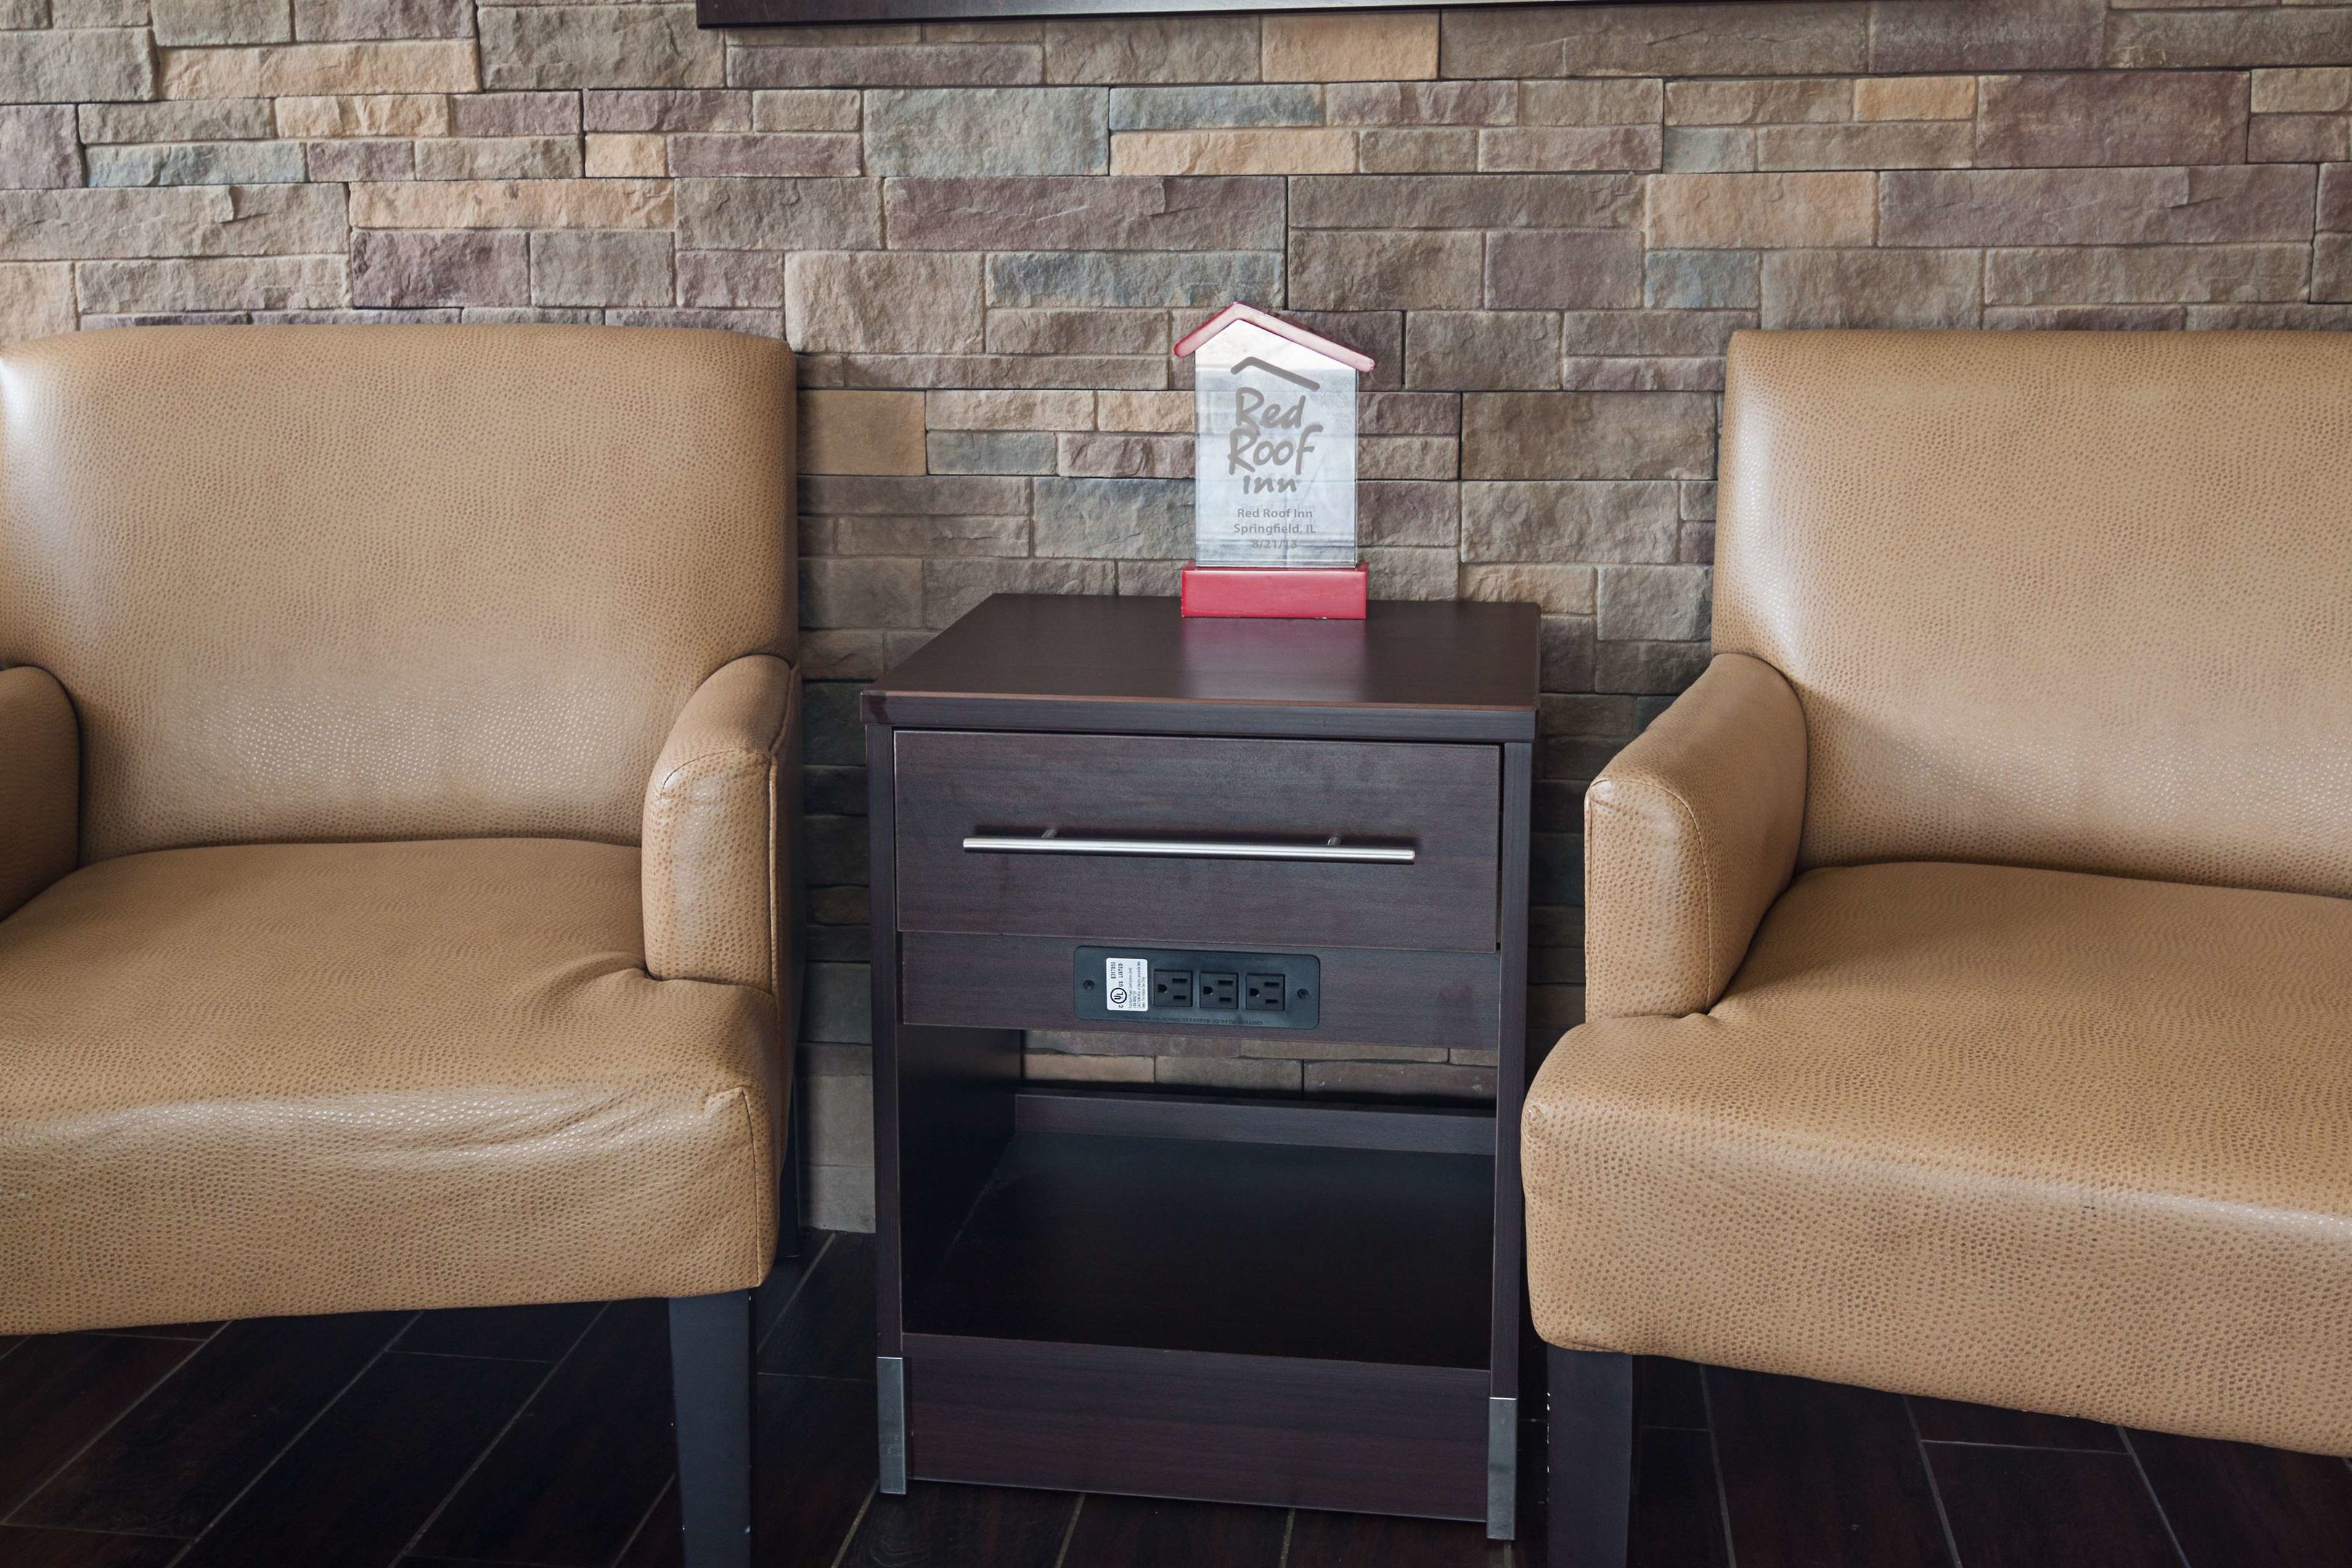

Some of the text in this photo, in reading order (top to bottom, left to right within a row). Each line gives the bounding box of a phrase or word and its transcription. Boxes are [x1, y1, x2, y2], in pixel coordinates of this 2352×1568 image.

[1236, 387, 1306, 429] Red
[1227, 423, 1323, 475] Roof
[1237, 508, 1312, 518] Red Roof Inn
[1233, 523, 1316, 535] Springfield, IL
